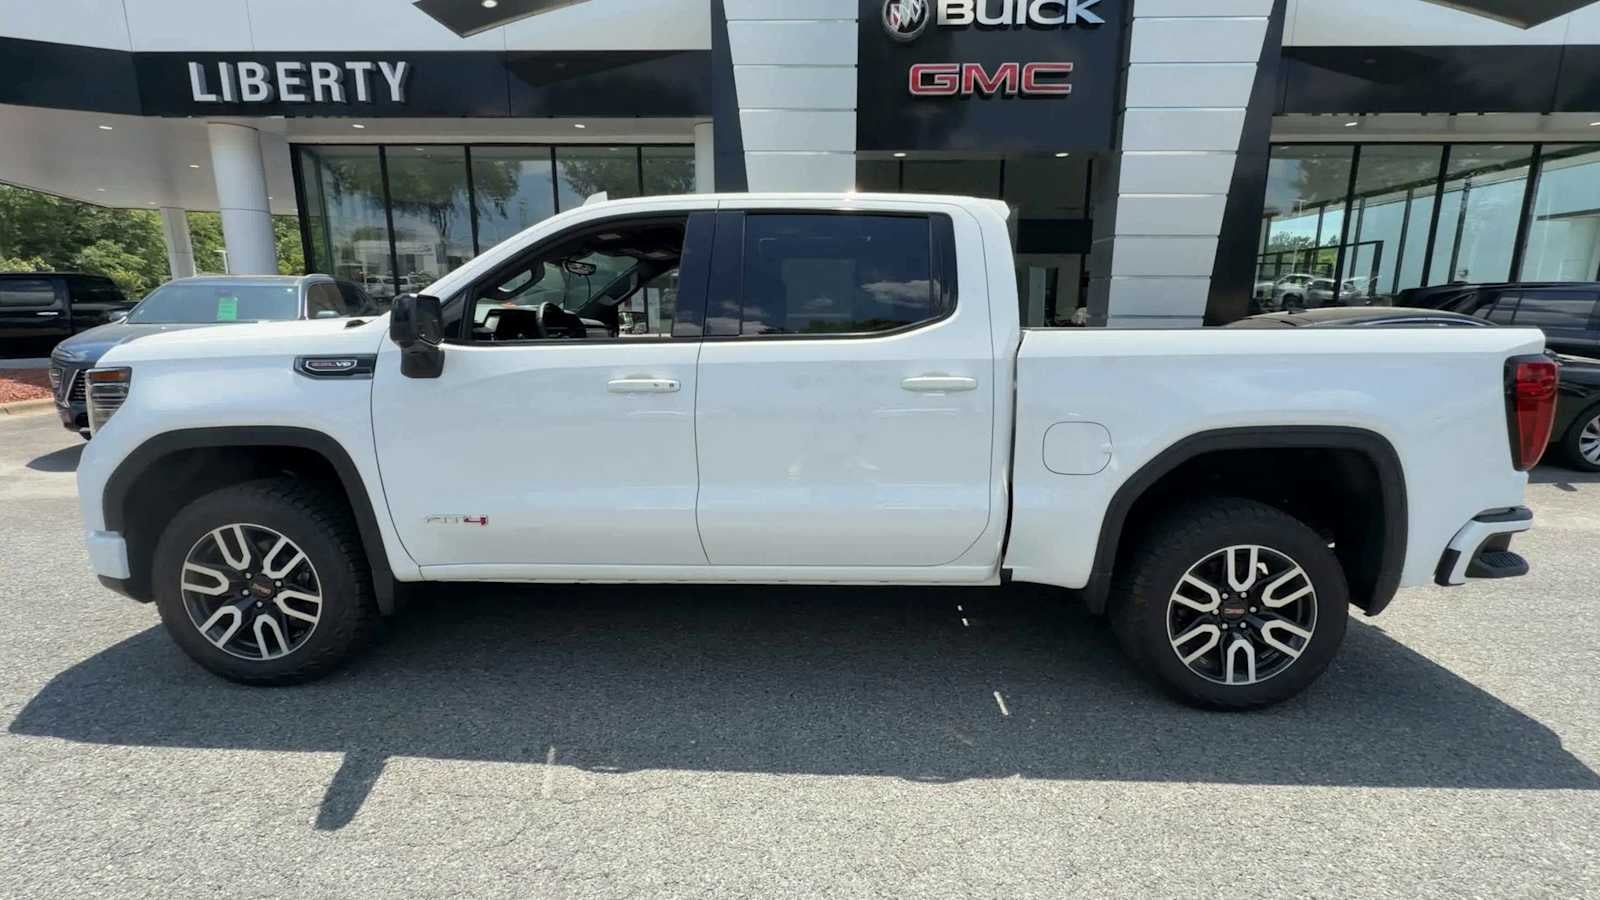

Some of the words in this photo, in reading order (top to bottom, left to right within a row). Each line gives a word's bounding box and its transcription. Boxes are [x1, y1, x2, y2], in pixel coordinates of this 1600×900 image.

[937, 0, 1106, 25] BUICK
[188, 61, 408, 102] LIBERTY
[909, 62, 1073, 95] GMC
